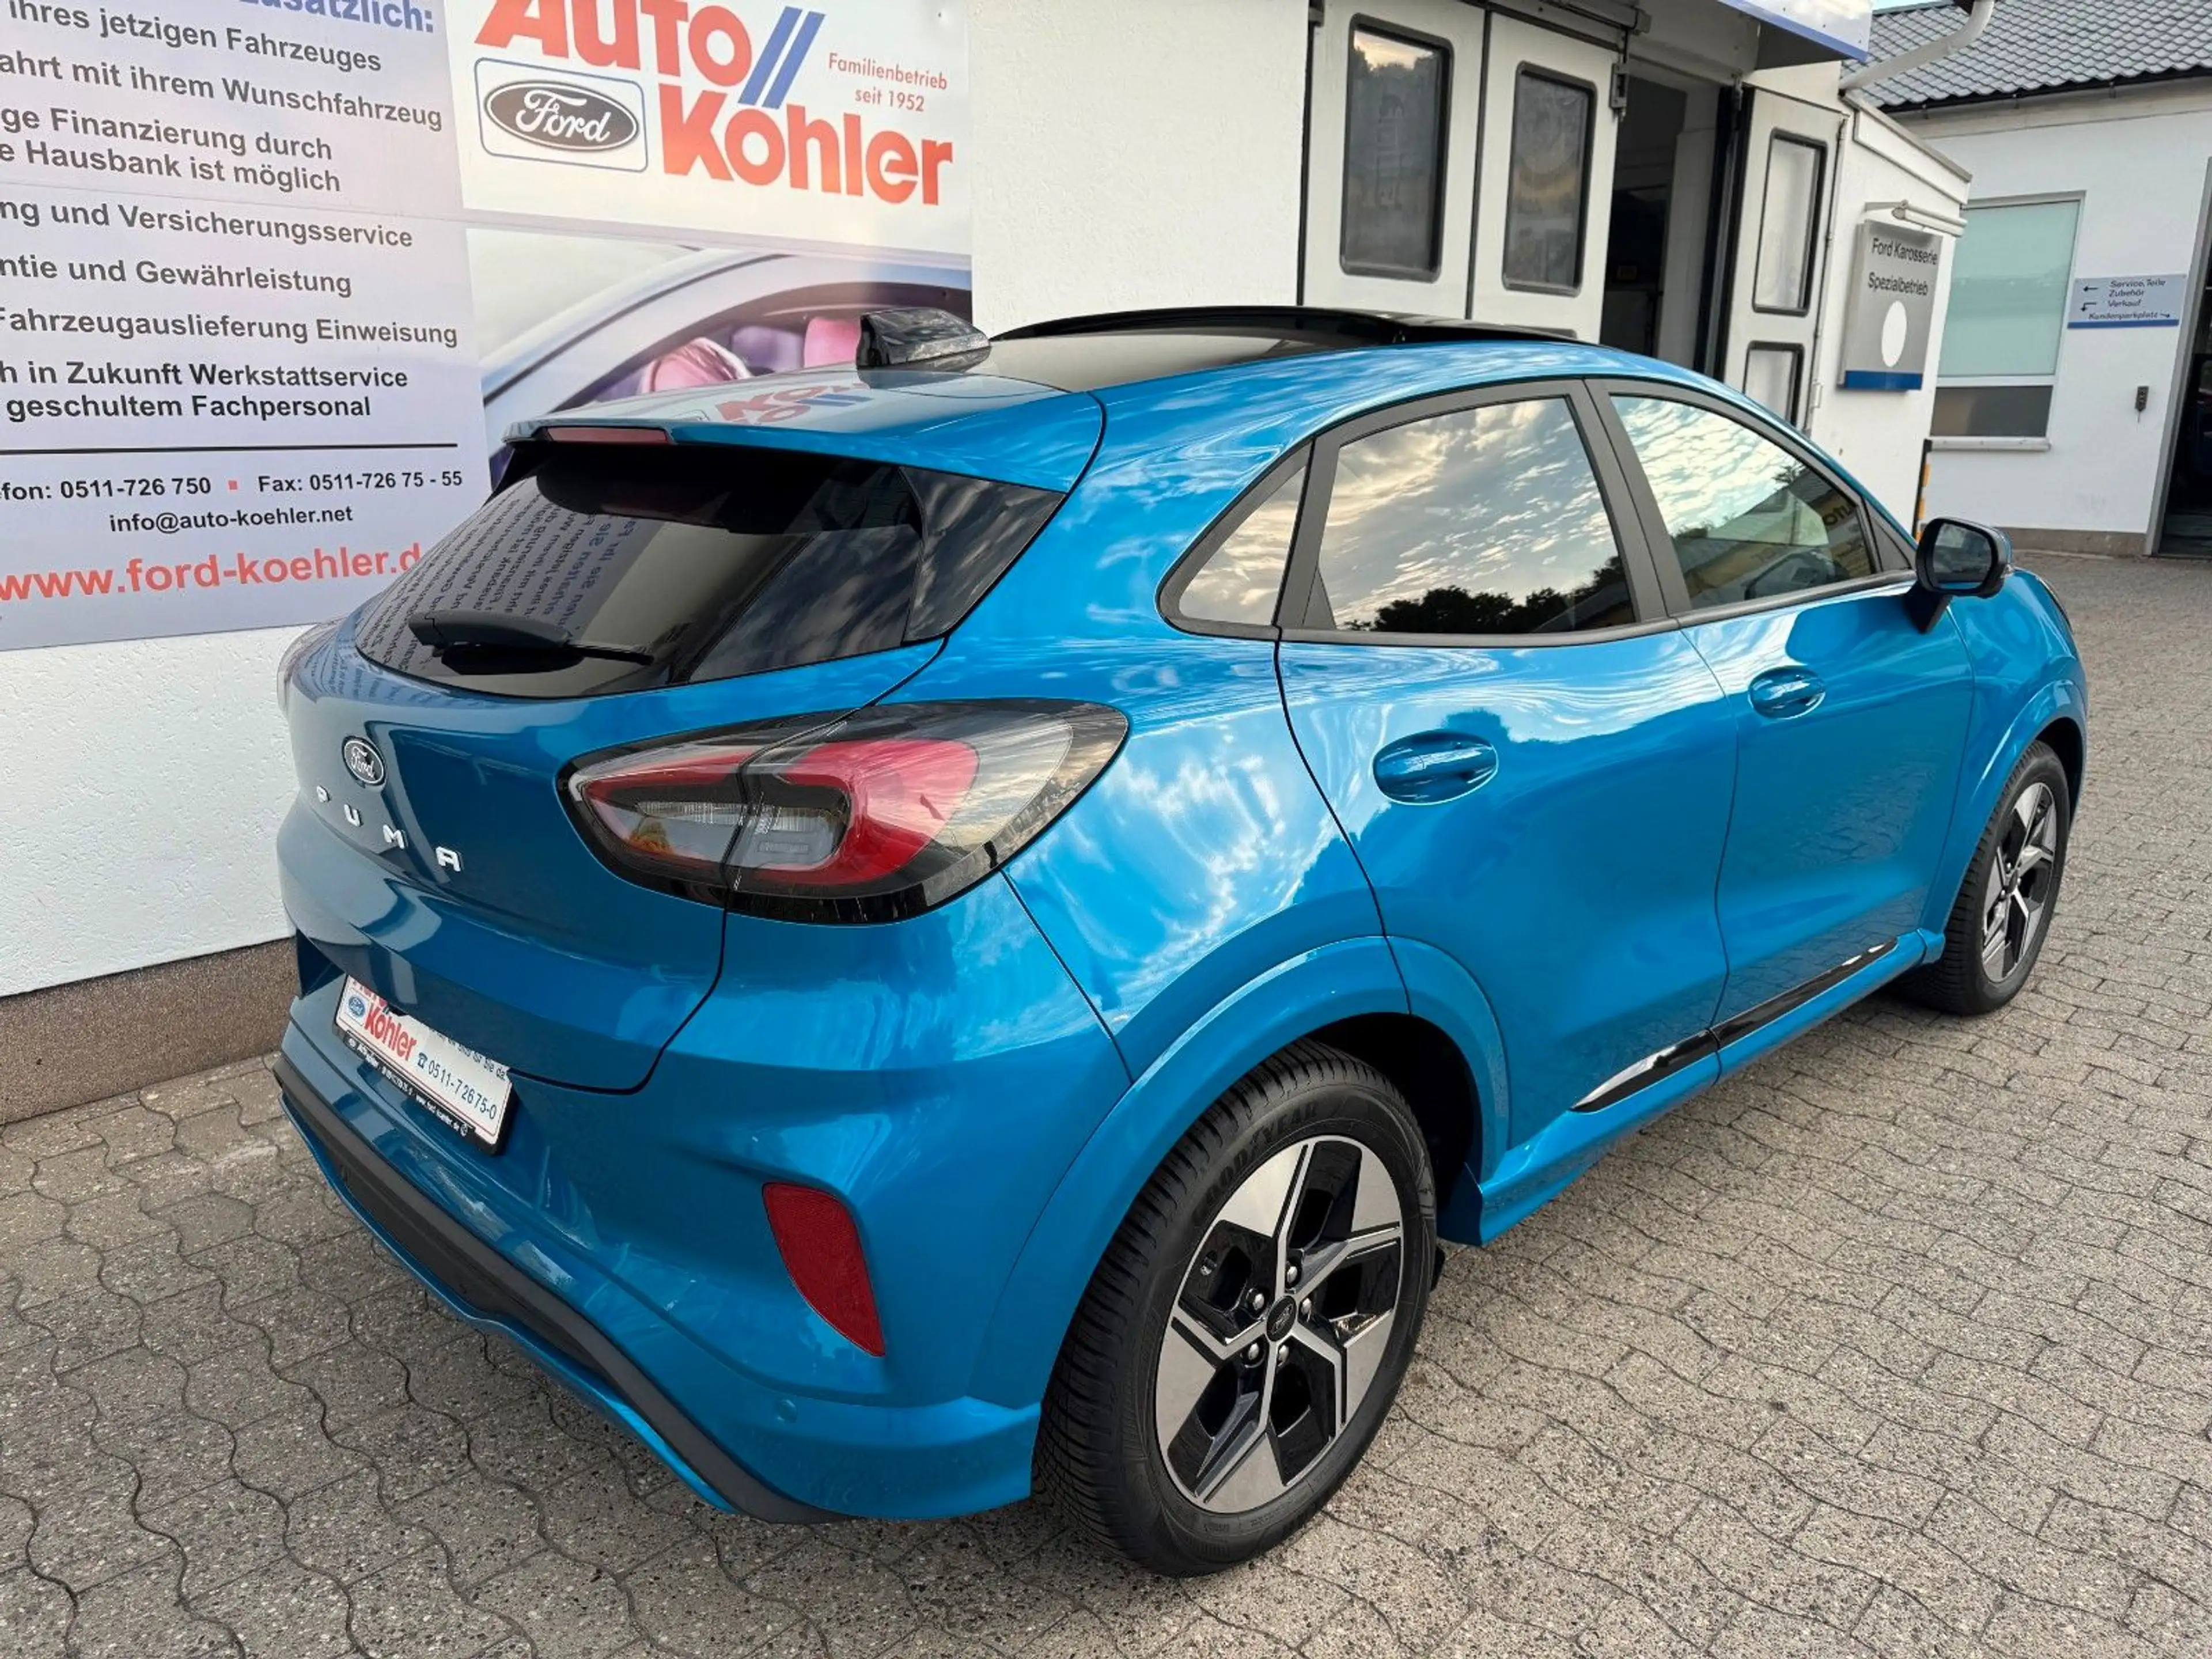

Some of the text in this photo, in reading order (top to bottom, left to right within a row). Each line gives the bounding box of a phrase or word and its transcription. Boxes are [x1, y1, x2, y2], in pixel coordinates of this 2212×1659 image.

[99, 7, 217, 48] jetzigen
[226, 28, 381, 72] Fahrzeuges
[829, 52, 948, 90] Familienbetrieb
[72, 62, 122, 87] mit
[130, 65, 214, 99] ihrem
[222, 77, 442, 132] Wunschfahrzeug
[855, 88, 925, 112] seit 1952
[514, 89, 611, 144] Ford
[50, 107, 246, 157] Finanzierung
[256, 132, 332, 160] durch
[25, 140, 182, 177] Hausbank
[190, 156, 226, 181] ist
[233, 164, 340, 192] möglich
[51, 203, 109, 226] und
[118, 204, 413, 247] Versicherungsservice
[1872, 237, 1938, 265] Ford Karosserie
[68, 260, 127, 281] und
[136, 261, 352, 298] Gewährleistung
[1868, 271, 1928, 296] Spezialbetrieb
[2108, 299, 2142, 307] Verkauf
[316, 319, 458, 348] Einweisung
[28, 361, 58, 384] in
[66, 361, 183, 385] Zukunft
[189, 363, 408, 387] Werkstattservice
[6, 395, 371, 422] geschultem Fachpersonal
[0, 482, 52, 501] fon:
[60, 479, 165, 499] 0511-726
[171, 476, 211, 495] 750
[258, 475, 302, 493] Fax:
[309, 472, 396, 491] 0511-726
[402, 472, 423, 488] 75
[442, 471, 463, 487] 55
[109, 505, 353, 534] info@auto-koehler.net
[351, 746, 376, 778] Ford
[316, 785, 462, 873] PUMA
